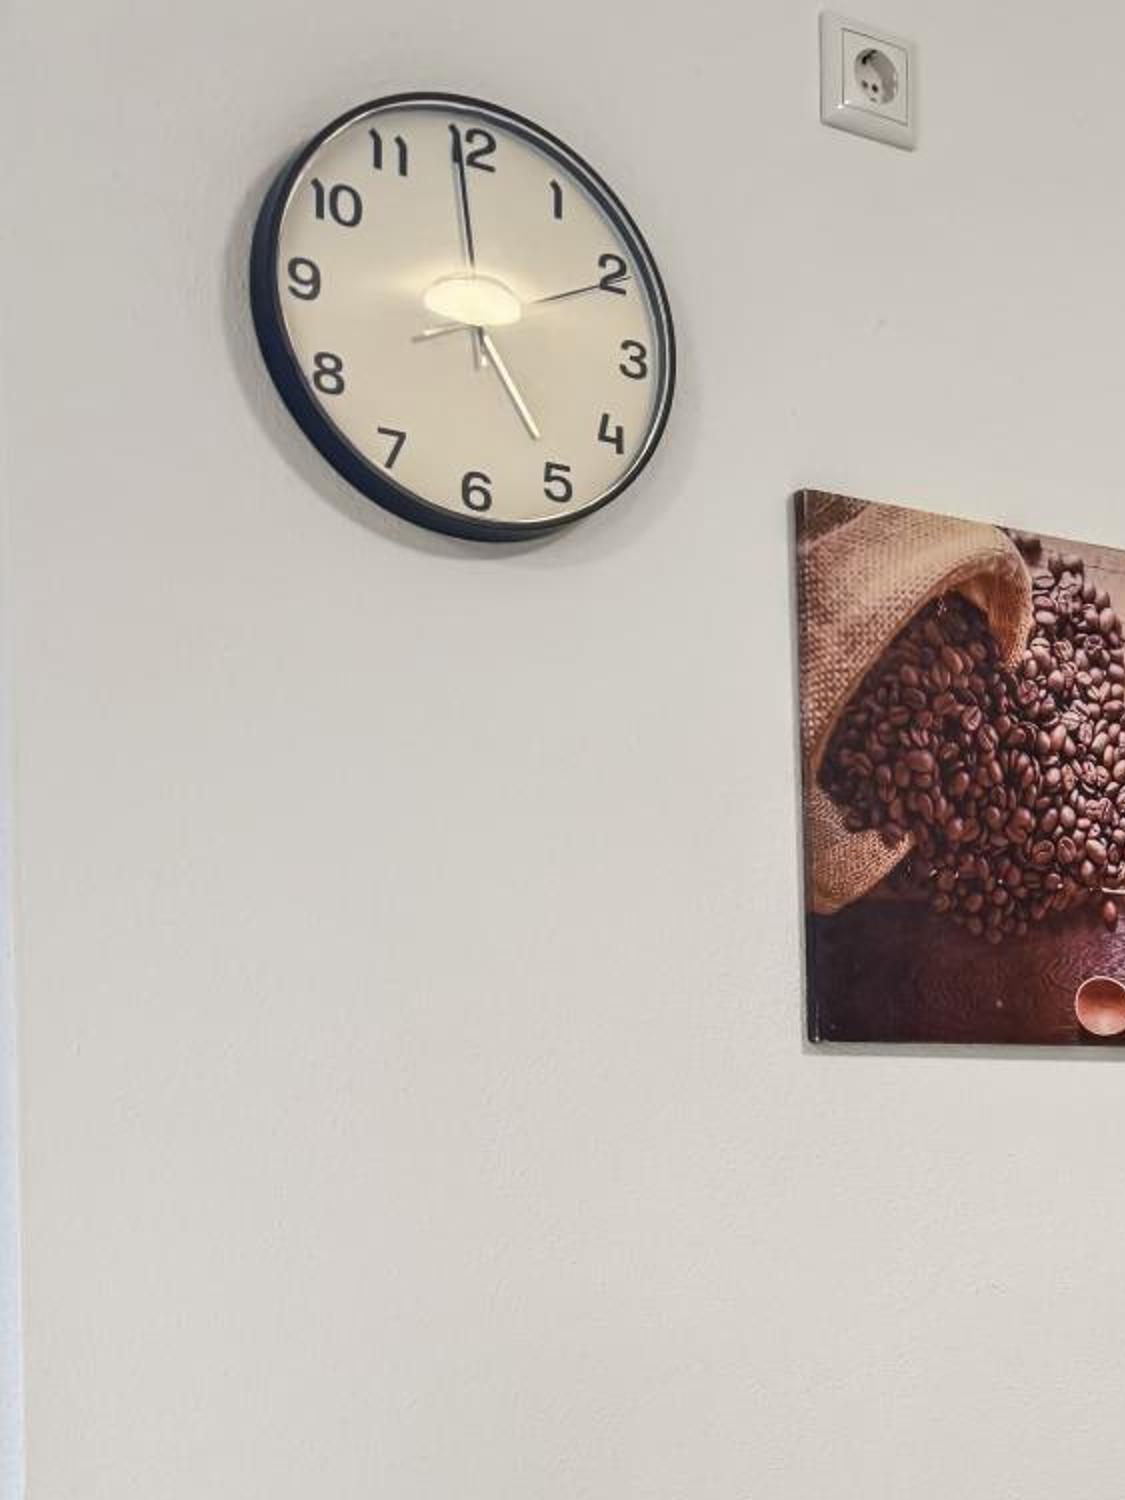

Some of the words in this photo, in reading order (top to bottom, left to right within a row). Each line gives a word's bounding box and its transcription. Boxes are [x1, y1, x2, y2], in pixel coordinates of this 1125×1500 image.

[369, 127, 408, 177] 11
[448, 123, 497, 173] 12
[311, 177, 364, 228] 10
[549, 179, 564, 220] 1
[287, 256, 322, 301] 9
[597, 253, 628, 295] 2
[312, 351, 346, 396] 8
[618, 339, 649, 381] 3
[376, 426, 407, 470] 7
[597, 412, 625, 455] 4
[461, 471, 493, 513] 6
[543, 461, 574, 503] 5
